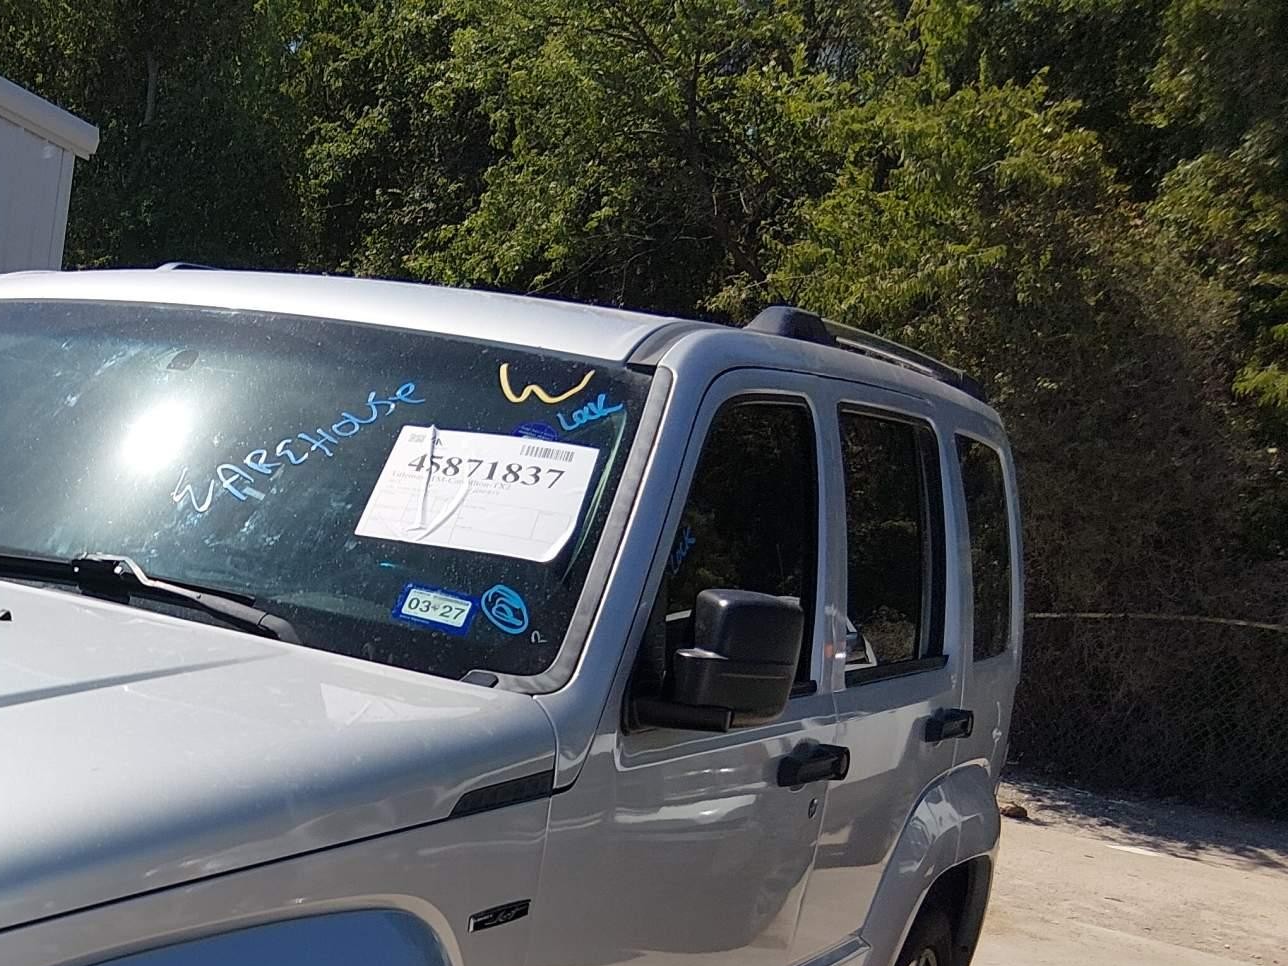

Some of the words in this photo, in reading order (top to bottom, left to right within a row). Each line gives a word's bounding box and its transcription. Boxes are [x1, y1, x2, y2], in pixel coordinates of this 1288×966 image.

[499, 362, 596, 404] W
[407, 452, 566, 489] 45871837
[408, 597, 432, 613] 03
[439, 604, 465, 621] 27
